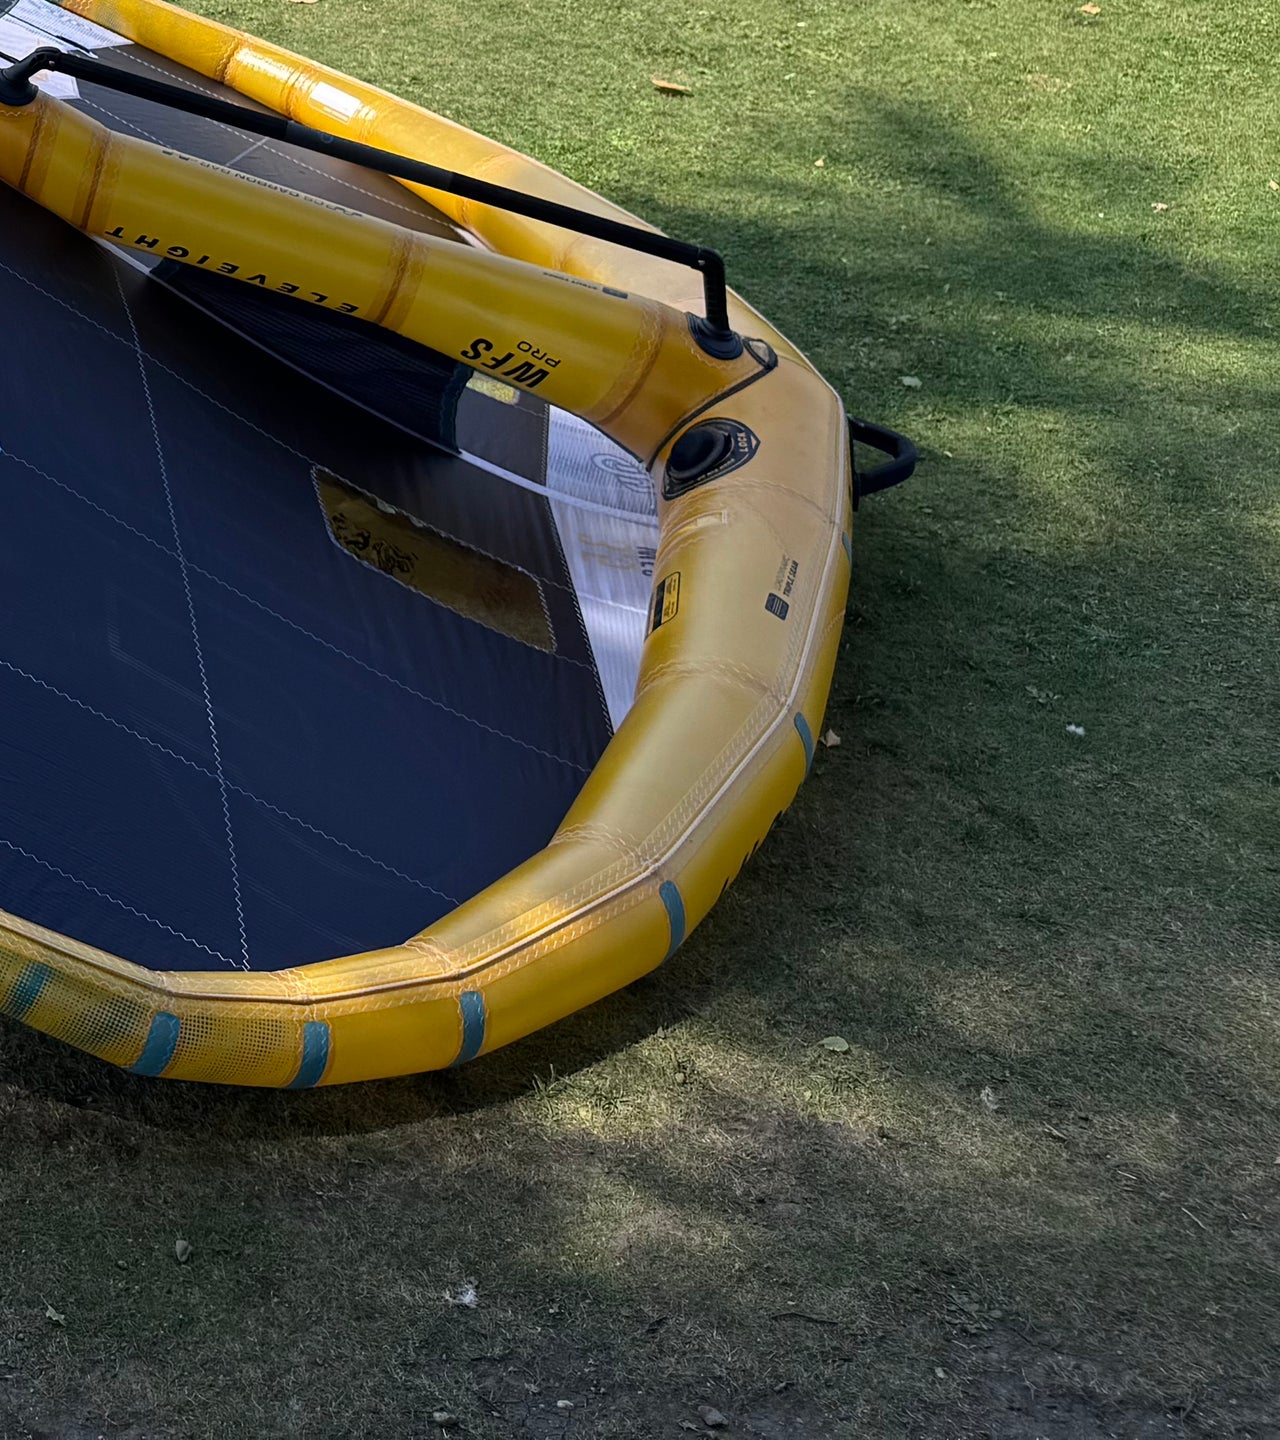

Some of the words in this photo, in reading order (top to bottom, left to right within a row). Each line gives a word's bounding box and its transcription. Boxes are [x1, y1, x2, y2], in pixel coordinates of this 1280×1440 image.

[234, 173, 300, 198] CARBON
[105, 226, 360, 314] ELEVEIGHT
[460, 338, 550, 388] WFS
[517, 340, 562, 368] PRO
[735, 432, 750, 453] LOCK
